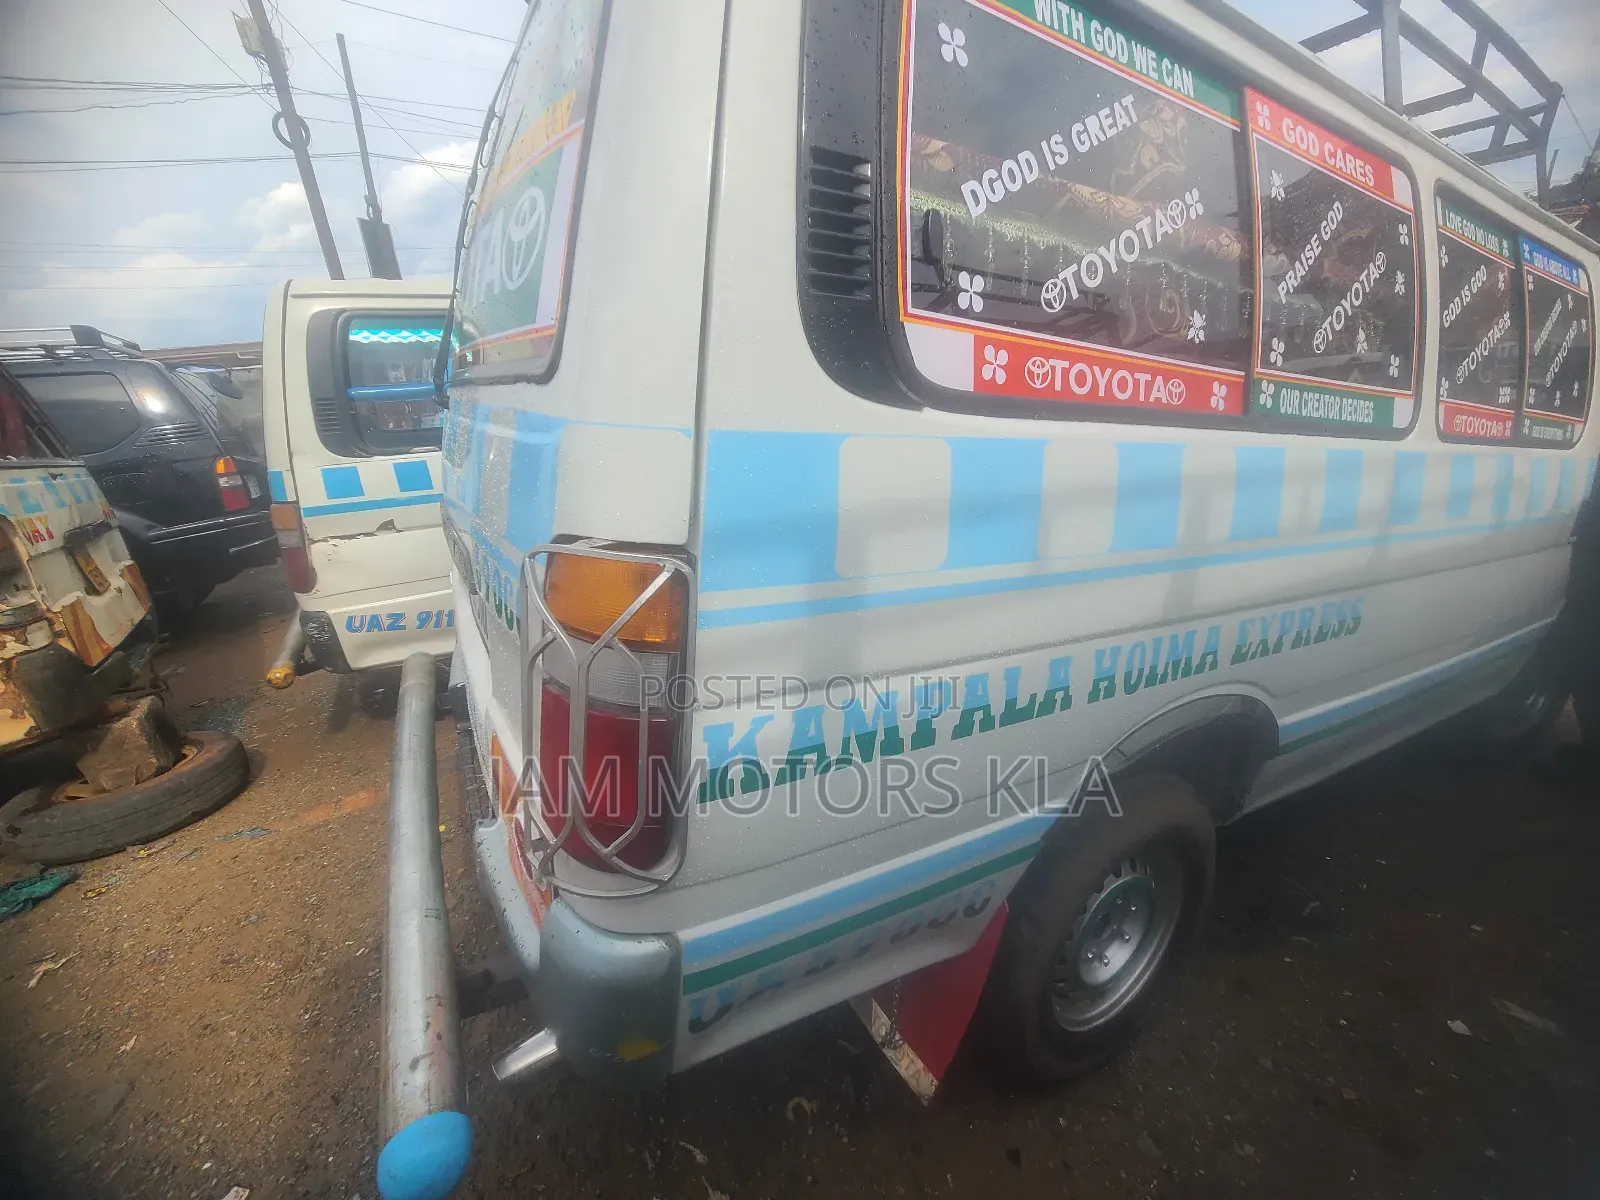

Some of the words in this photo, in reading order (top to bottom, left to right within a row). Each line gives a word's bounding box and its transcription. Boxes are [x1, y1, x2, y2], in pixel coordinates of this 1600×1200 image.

[1033, 0, 1086, 43] WITH
[1090, 19, 1128, 65] GOD
[1131, 41, 1159, 81] WE
[1161, 58, 1194, 98] CAN
[961, 150, 1040, 218] DGOD
[1040, 133, 1069, 170] IS
[1071, 94, 1139, 153] GREAT
[1282, 117, 1320, 157] GOD
[1324, 142, 1375, 186] CARES
[1059, 210, 1174, 300] TOYOTA
[1277, 233, 1323, 304] PRAISE
[1320, 201, 1344, 241] GOD
[1322, 262, 1380, 342] TOYOTA
[1442, 296, 1462, 328] GOD
[1461, 284, 1471, 306] IS
[1049, 359, 1168, 404] TOYOTA
[1461, 326, 1501, 377] TOYOTA
[1279, 387, 1300, 415] OUR
[1301, 392, 1341, 419] CREATOR
[1341, 398, 1374, 424] DECIDES
[1461, 416, 1499, 438] TOYOTA
[345, 611, 407, 633] UAZ
[415, 609, 455, 630] 911
[695, 656, 1073, 804] KAMPALA
[1087, 624, 1221, 704] HOIMA
[1230, 596, 1366, 666] EXPRESS
